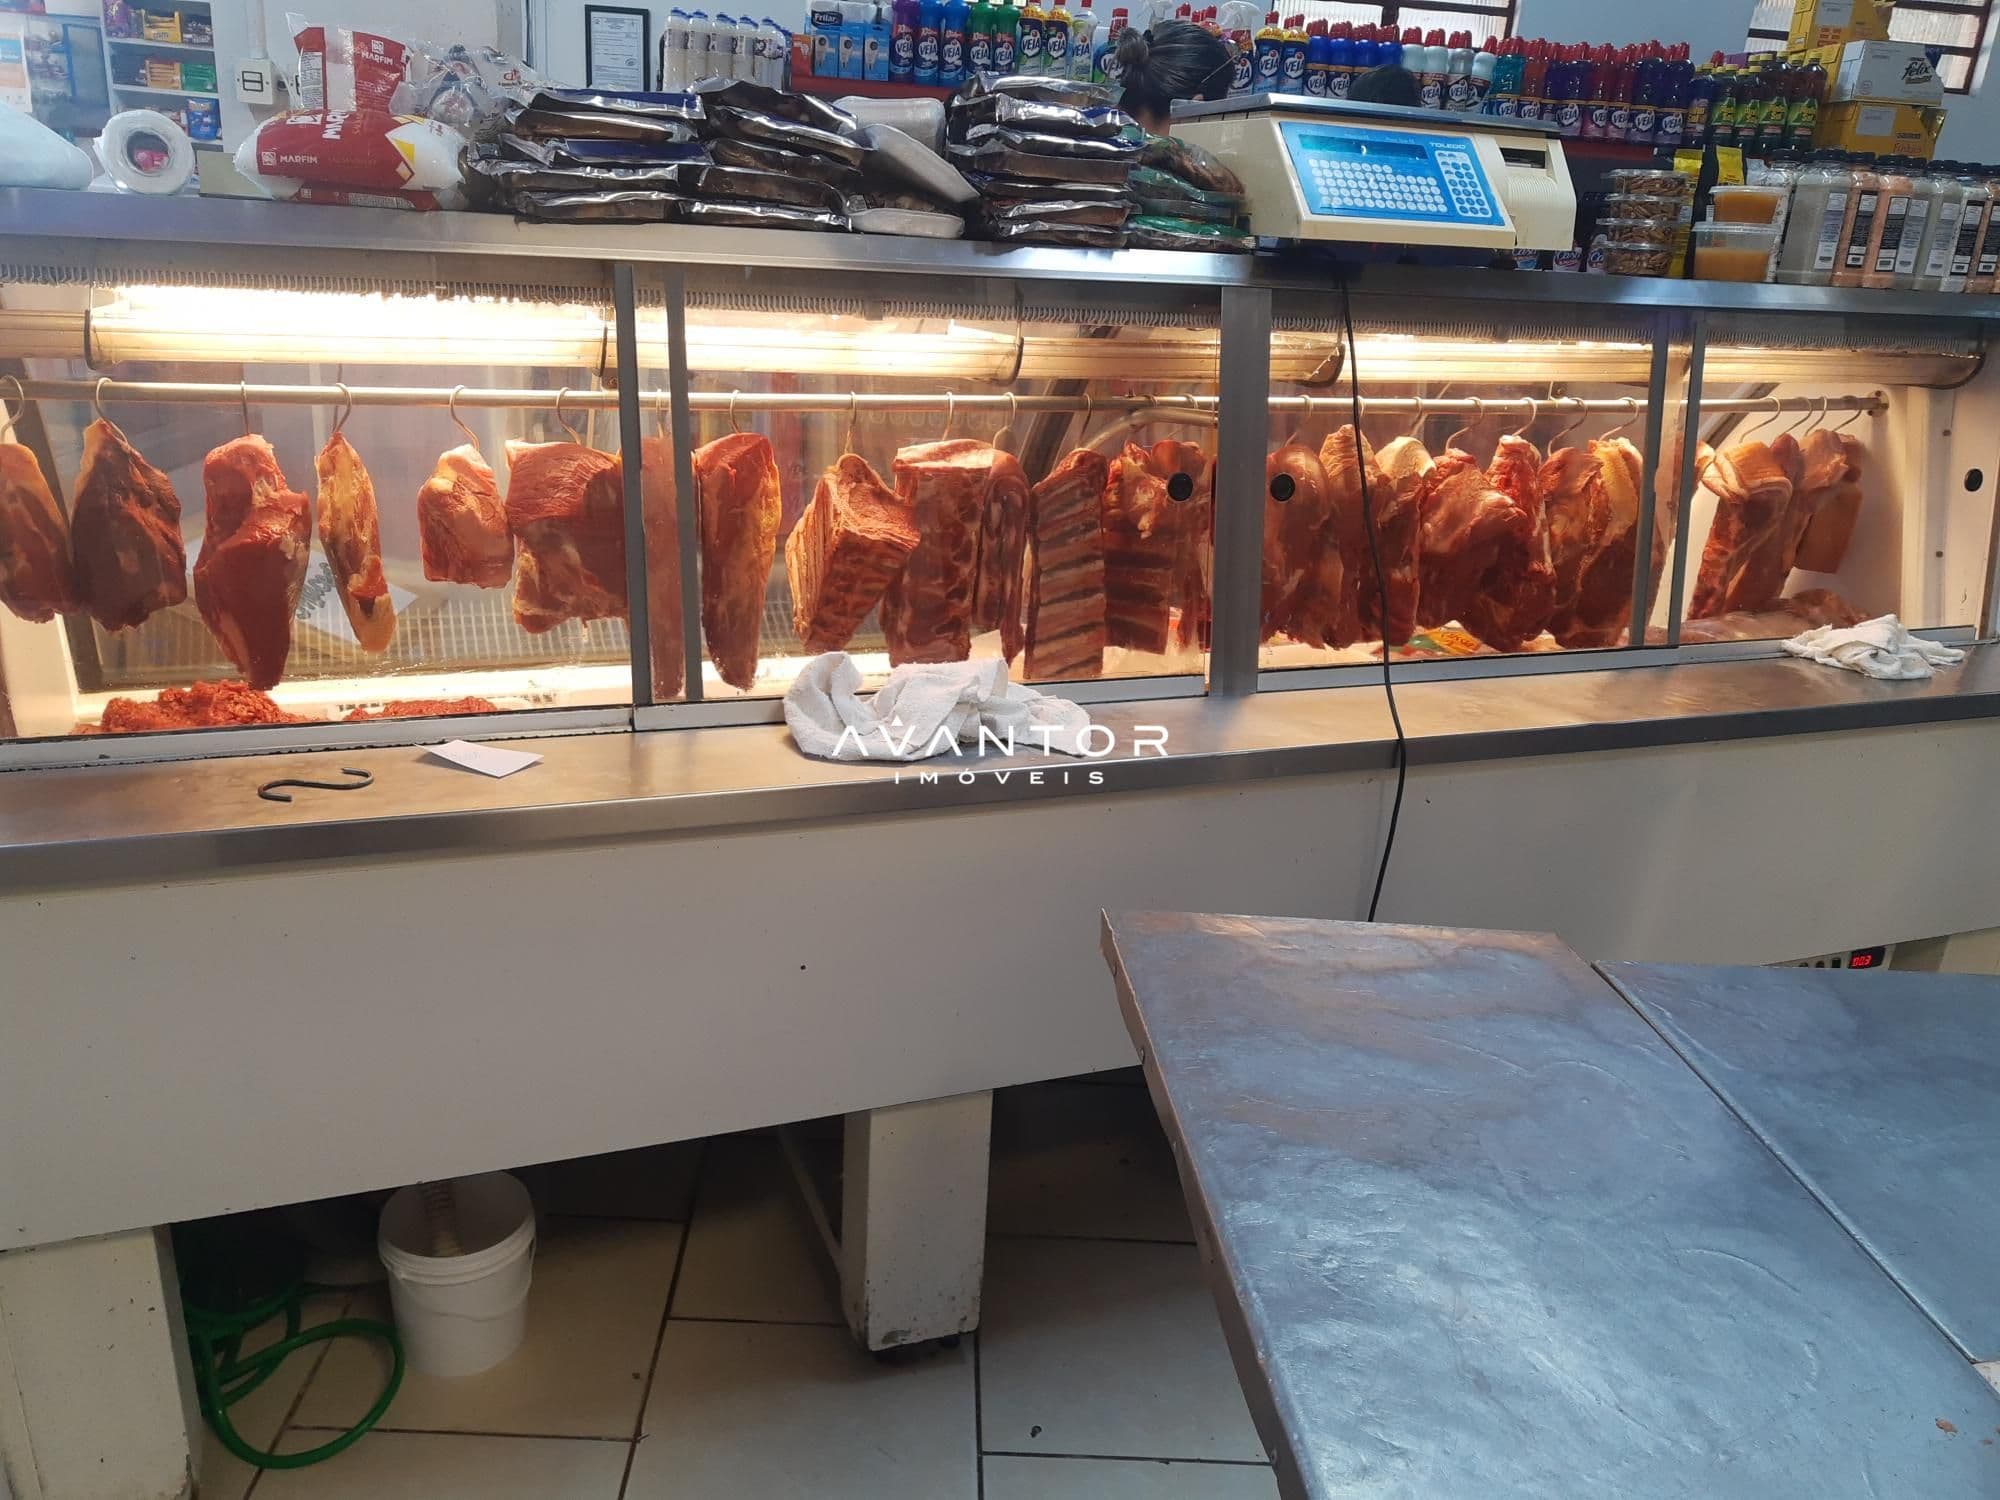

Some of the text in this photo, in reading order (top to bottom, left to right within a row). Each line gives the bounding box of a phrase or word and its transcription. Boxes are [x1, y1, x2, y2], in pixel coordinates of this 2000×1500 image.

[1022, 37, 1041, 50] VEJA
[1048, 39, 1067, 53] VEJA
[361, 51, 393, 66] MARFIM
[1260, 58, 1279, 70] VEJA
[1285, 60, 1303, 73] VEJA
[1430, 142, 1466, 150] TOLEDO
[280, 154, 318, 164] MARFIM
